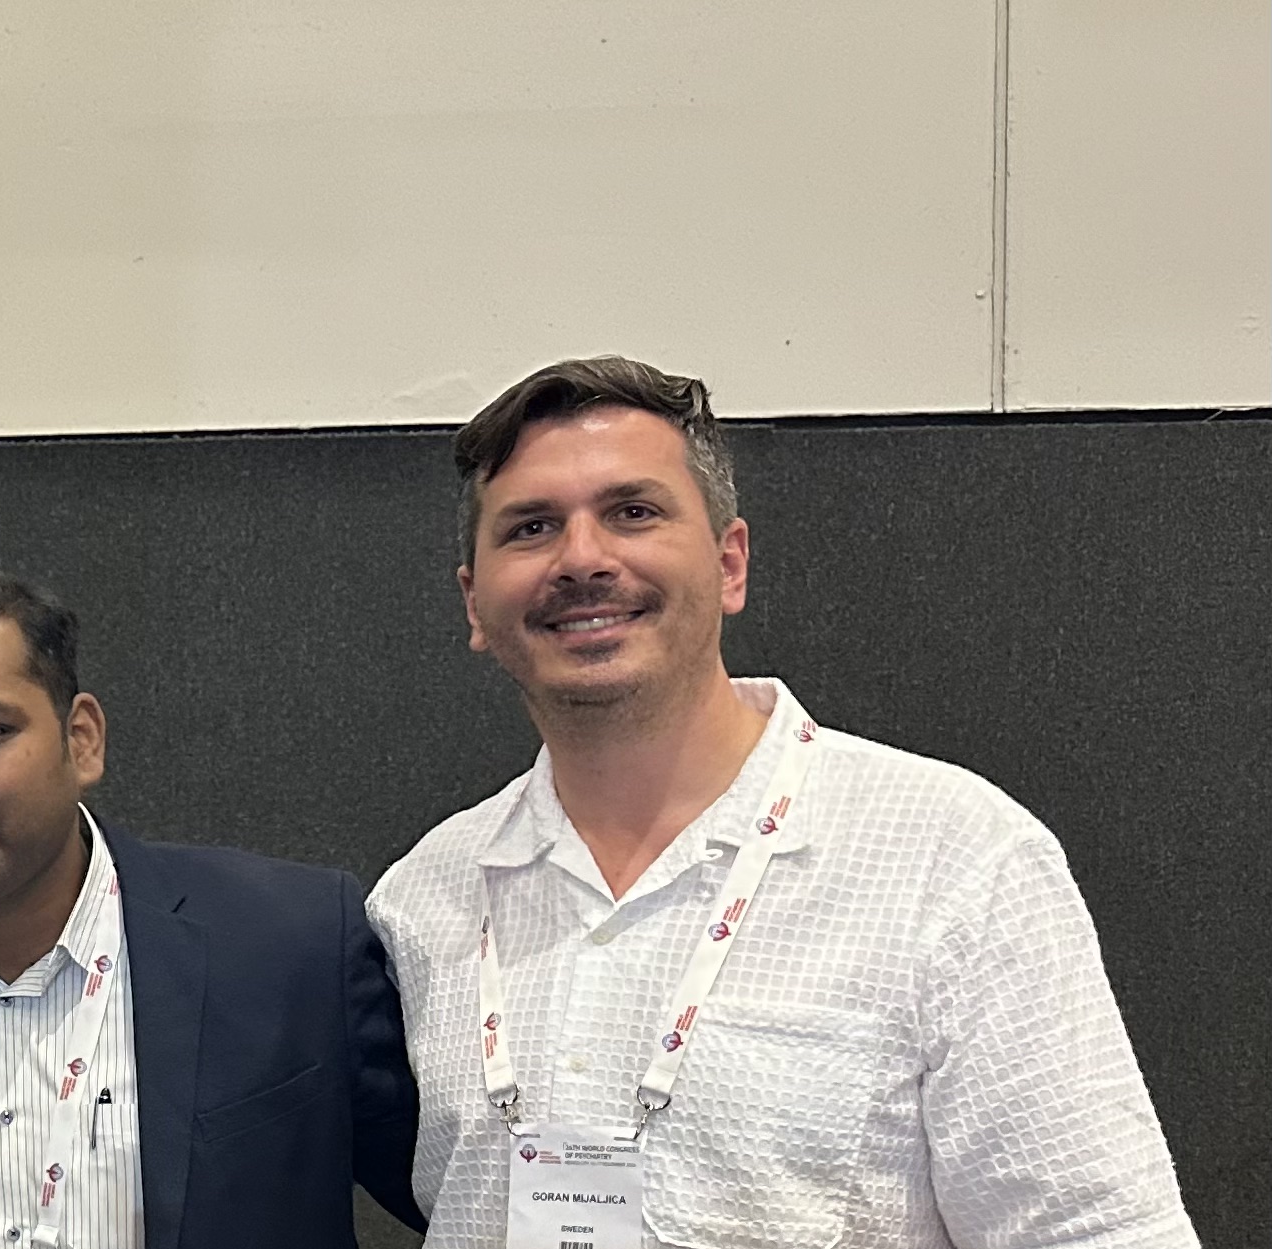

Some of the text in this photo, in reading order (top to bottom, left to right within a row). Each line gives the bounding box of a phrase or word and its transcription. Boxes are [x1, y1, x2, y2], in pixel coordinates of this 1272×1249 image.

[532, 1192, 627, 1205] GORAN MIJALJICA
[561, 1225, 594, 1234] SWEDEN
